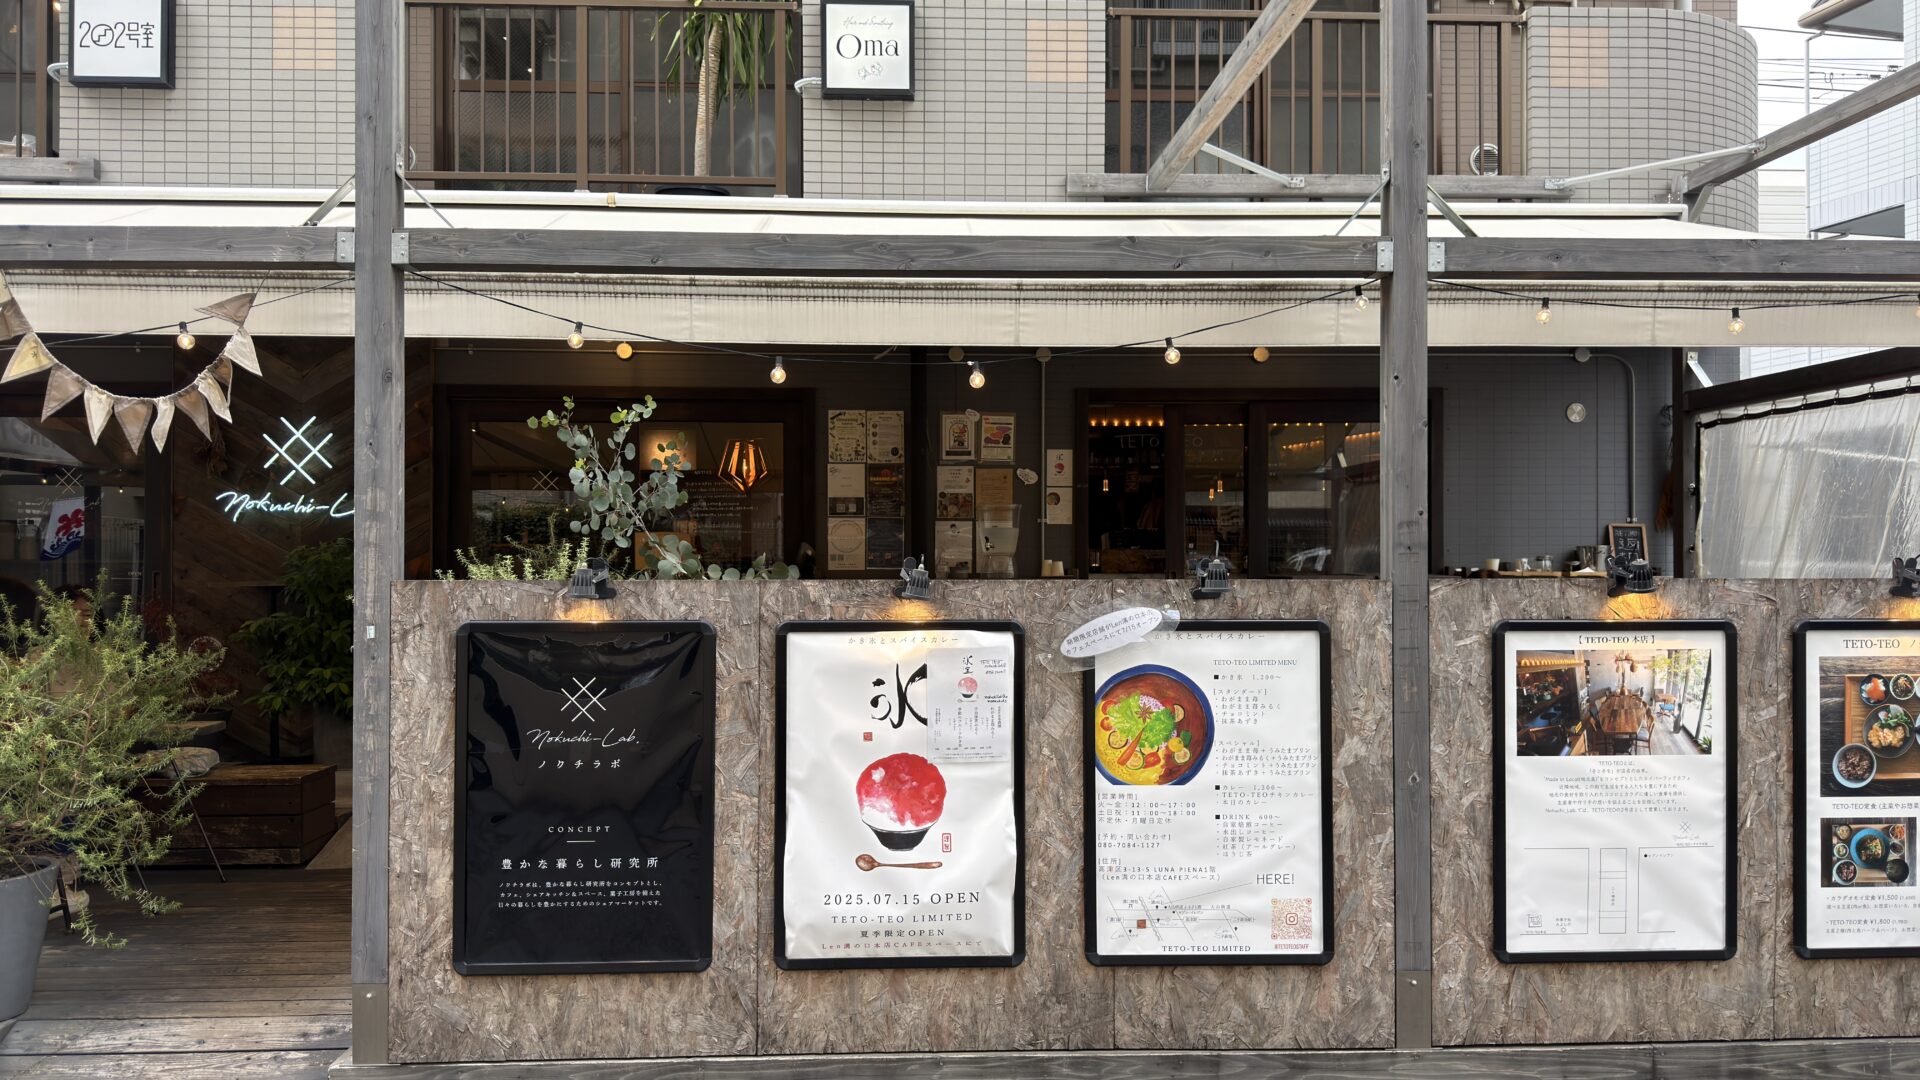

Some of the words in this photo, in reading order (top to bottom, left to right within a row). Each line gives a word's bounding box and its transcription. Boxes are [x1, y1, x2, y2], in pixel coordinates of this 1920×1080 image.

[836, 34, 899, 59] Oma
[1843, 639, 1900, 648] TETO-TEO
[538, 758, 621, 769] ノクチラボ
[501, 857, 659, 870] 豊かな暮らし研究所
[1256, 874, 1295, 885] HERE!
[824, 894, 920, 905] 2025.07.15
[930, 892, 980, 904] OPEN
[832, 915, 904, 924] TETO-TEO
[913, 913, 973, 923] LIMITED
[861, 929, 945, 938] 夏季限定OPEN
